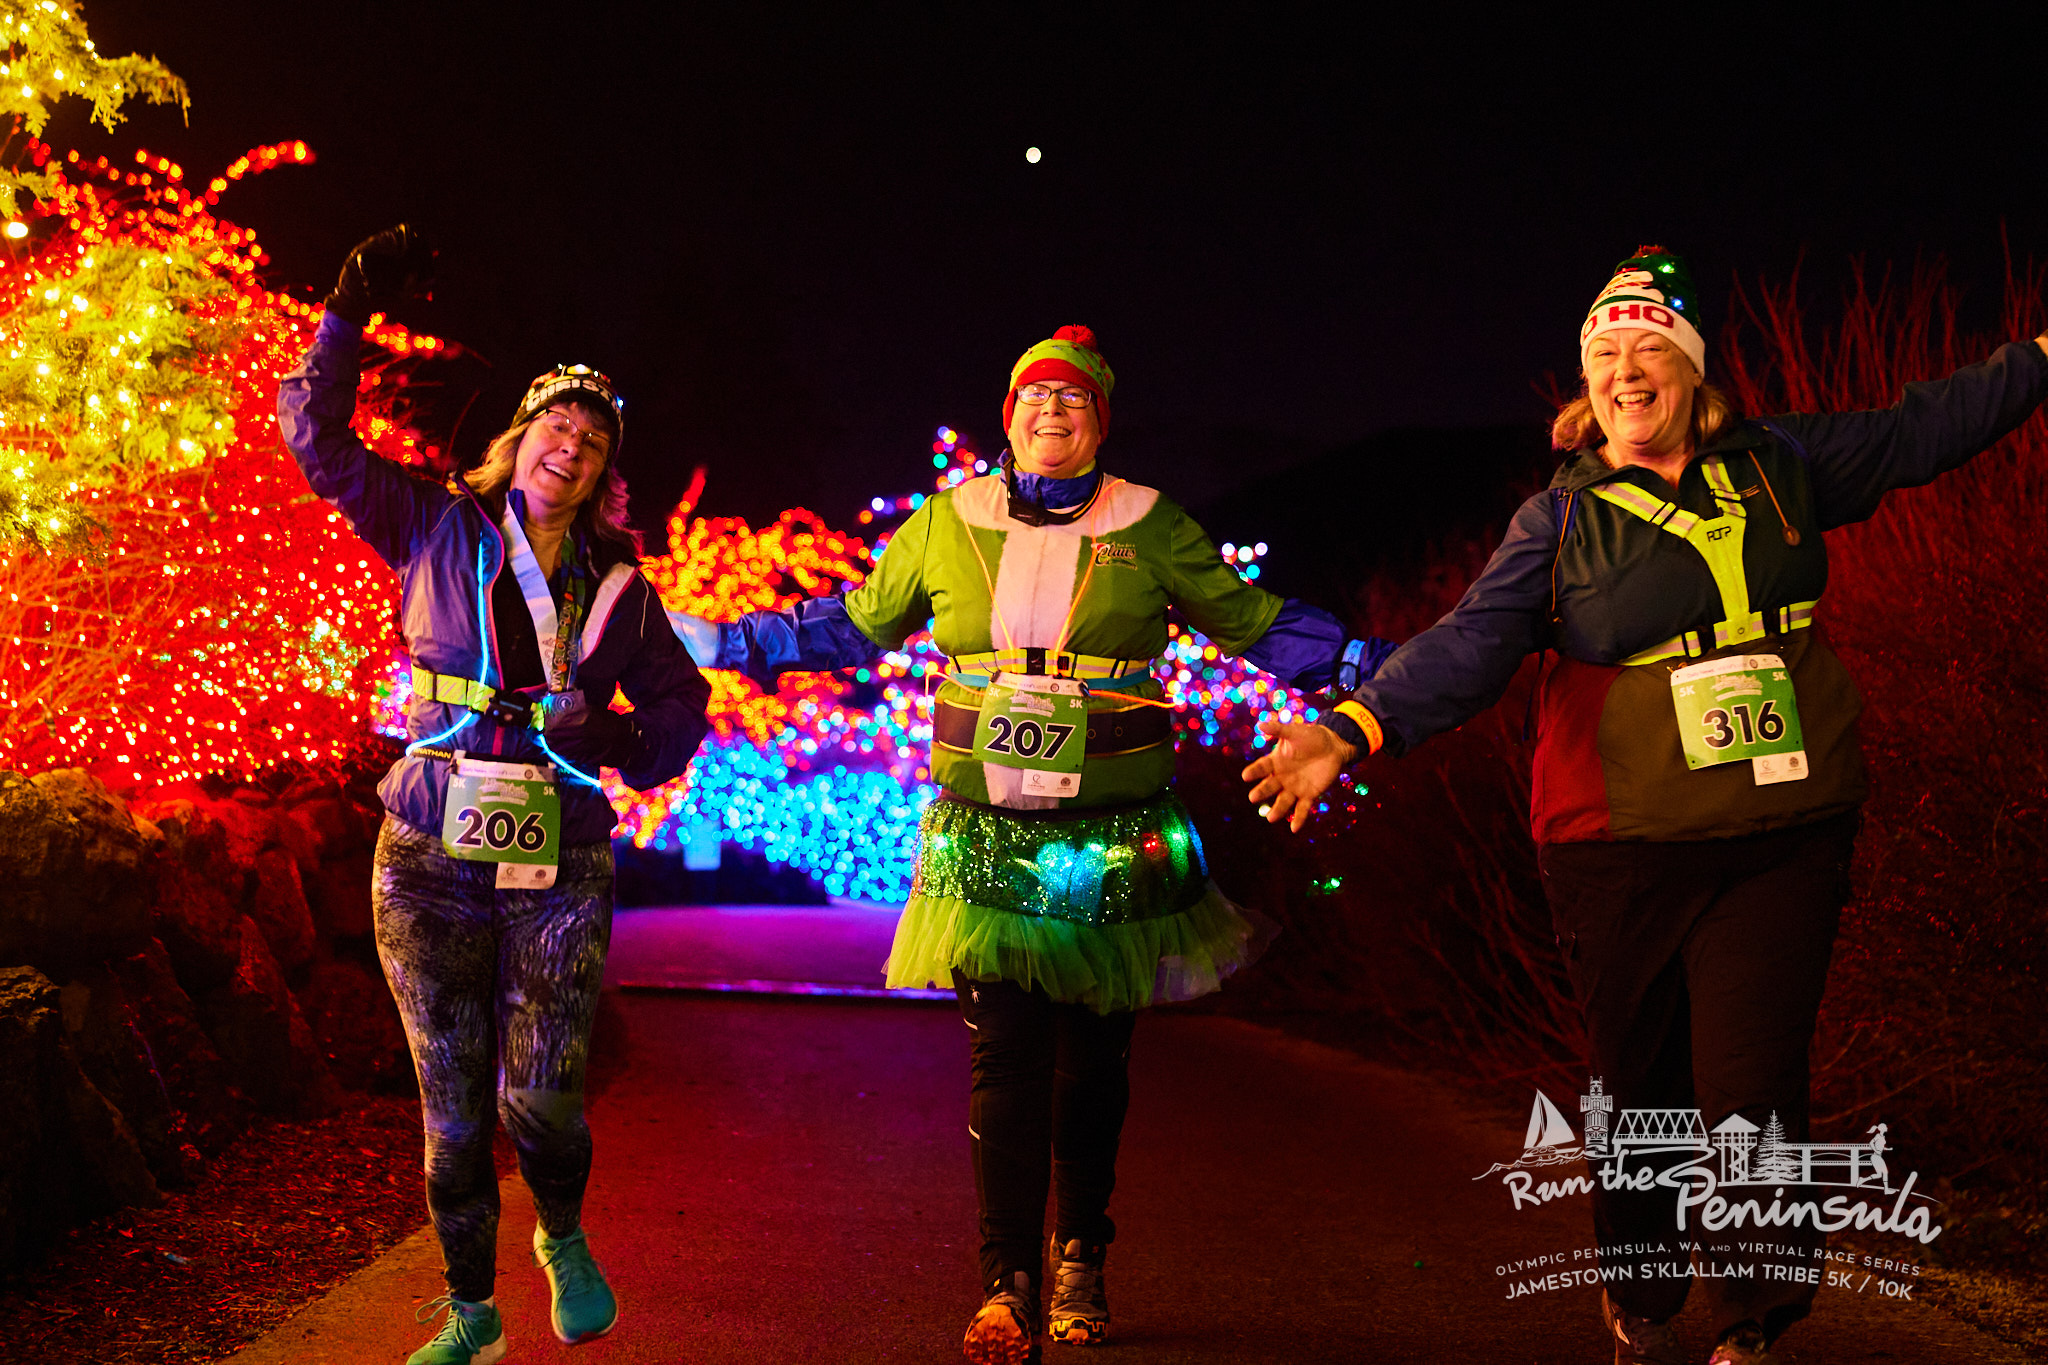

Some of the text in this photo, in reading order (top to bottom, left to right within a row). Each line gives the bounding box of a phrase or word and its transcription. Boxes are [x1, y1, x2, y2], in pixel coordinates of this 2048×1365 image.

[1609, 304, 1674, 329] HO
[1094, 541, 1137, 567] Claus
[1772, 672, 1787, 681] 5K
[988, 686, 1001, 698] 5K
[1680, 685, 1695, 697] 5K
[1069, 697, 1084, 709] 5K
[1702, 700, 1786, 750] 316
[983, 715, 1077, 760] 207
[452, 777, 466, 789] 5K
[543, 785, 556, 797] 5K
[455, 807, 546, 851] 206
